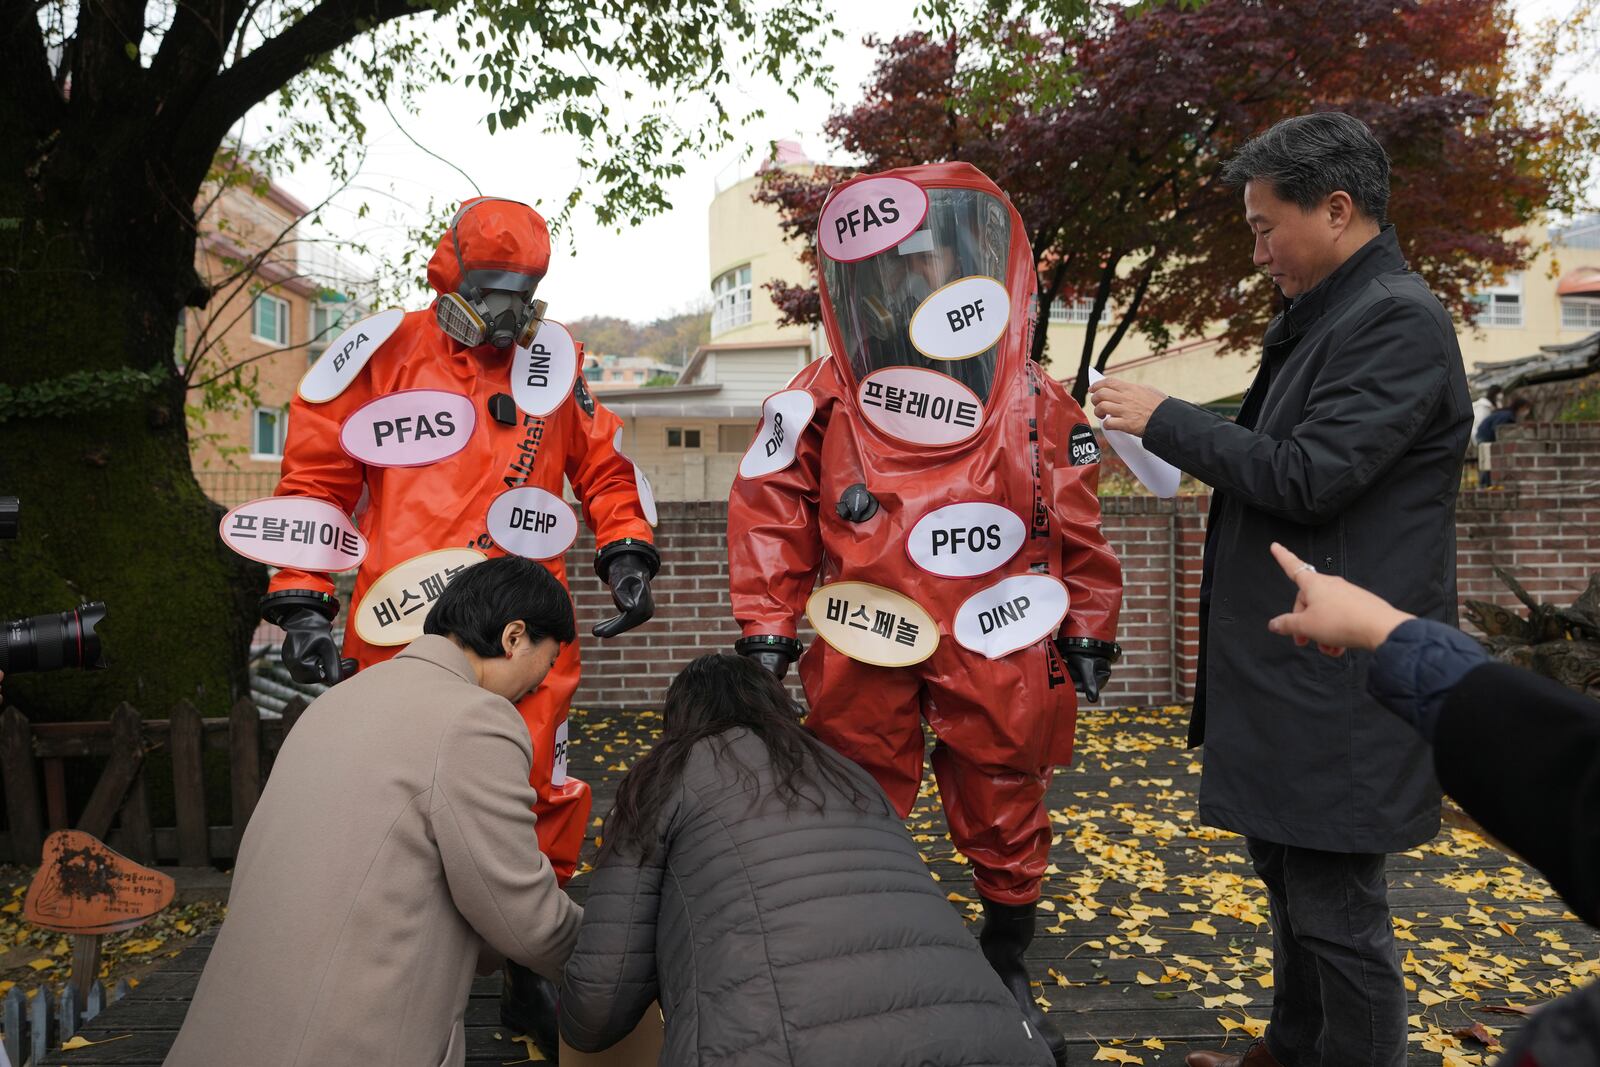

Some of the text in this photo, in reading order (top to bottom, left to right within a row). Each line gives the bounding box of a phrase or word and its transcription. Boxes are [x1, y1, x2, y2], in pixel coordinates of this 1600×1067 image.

[835, 198, 900, 244] PFAS
[946, 299, 985, 333] BPF
[332, 332, 370, 374] BPA
[527, 343, 549, 389] DINP
[863, 380, 978, 429] 프탈레이트
[373, 411, 456, 448] PFAS
[1072, 442, 1096, 458] evo
[230, 515, 360, 557] 프탈레이트
[509, 507, 557, 534] DEHP
[931, 523, 1002, 556] PFOS
[826, 596, 920, 647] 비스페놀
[978, 595, 1031, 635] DINP
[554, 740, 567, 765] PF
